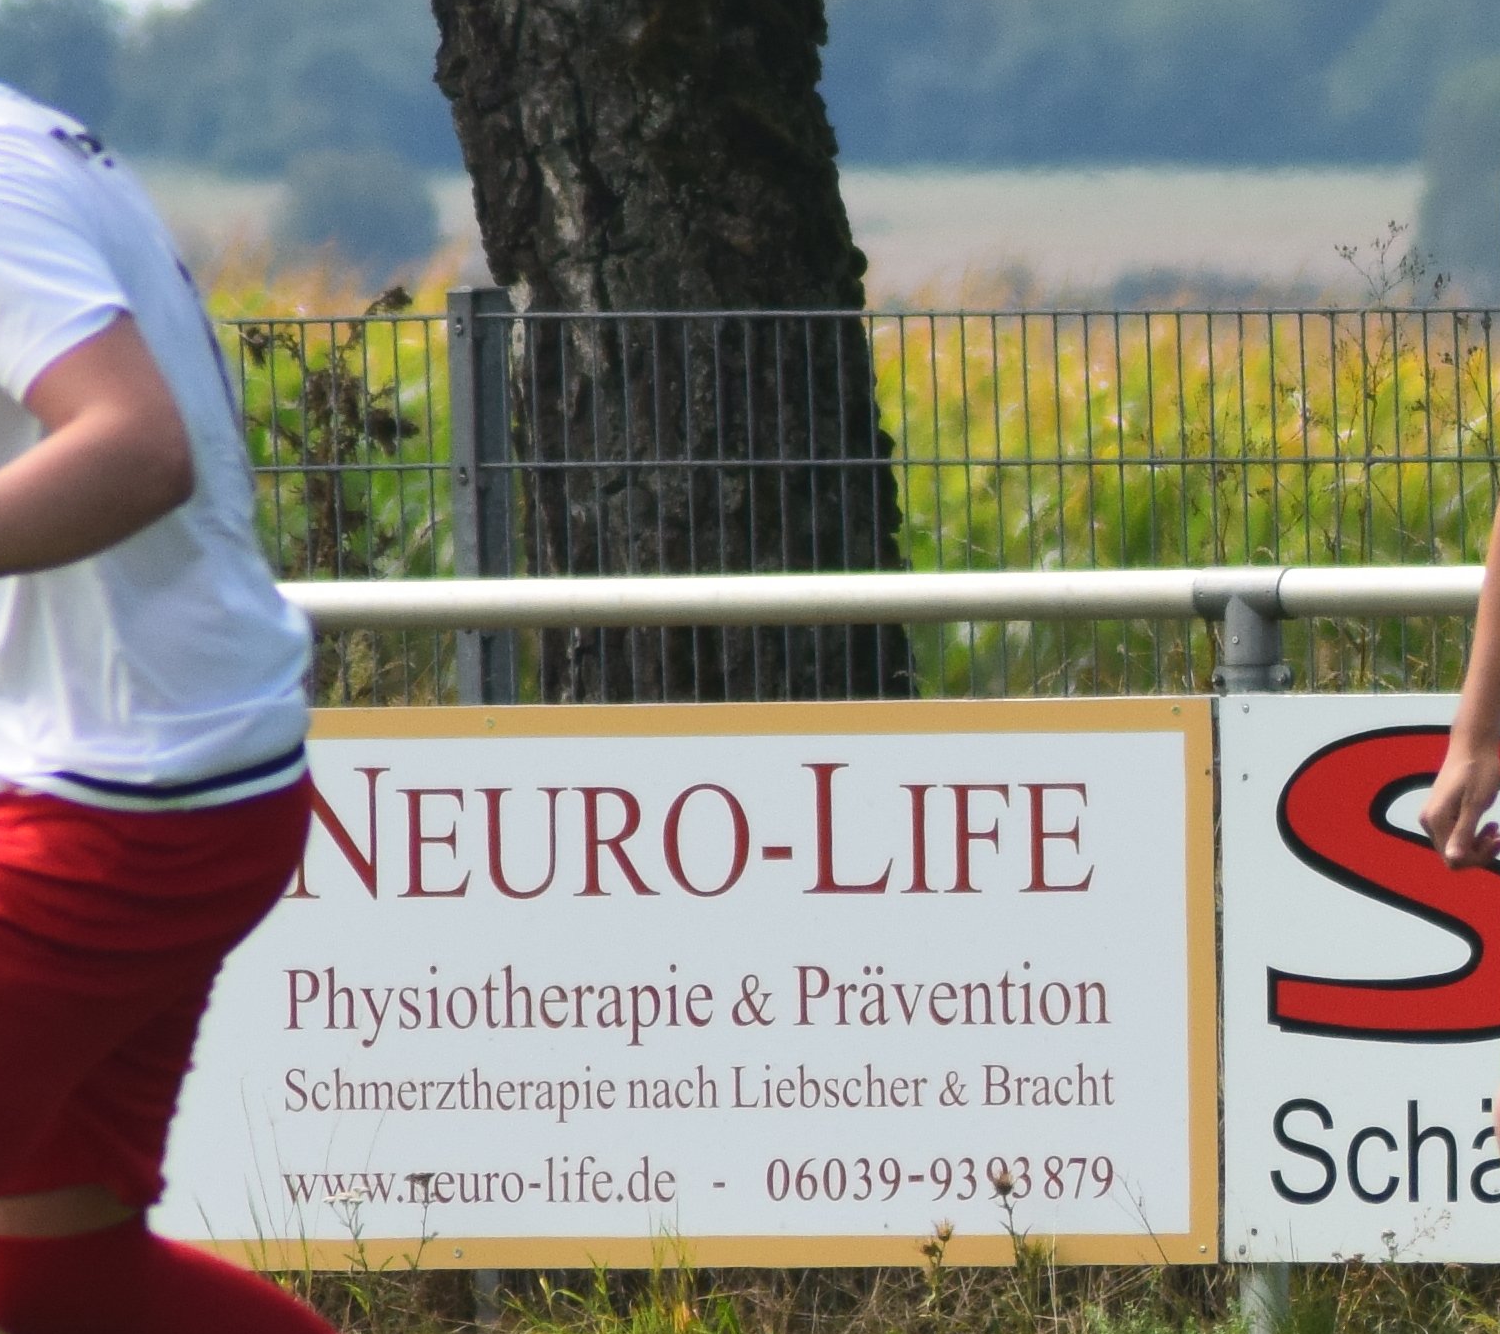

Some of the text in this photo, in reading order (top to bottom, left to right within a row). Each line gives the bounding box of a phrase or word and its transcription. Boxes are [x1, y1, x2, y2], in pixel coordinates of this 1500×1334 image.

[284, 962, 1109, 1049] Physiotherapie & Prävention
[285, 1062, 1115, 1123] Schmerztherapie nach Liebscher & Bracht
[283, 1155, 677, 1205] www.neuro-life.de
